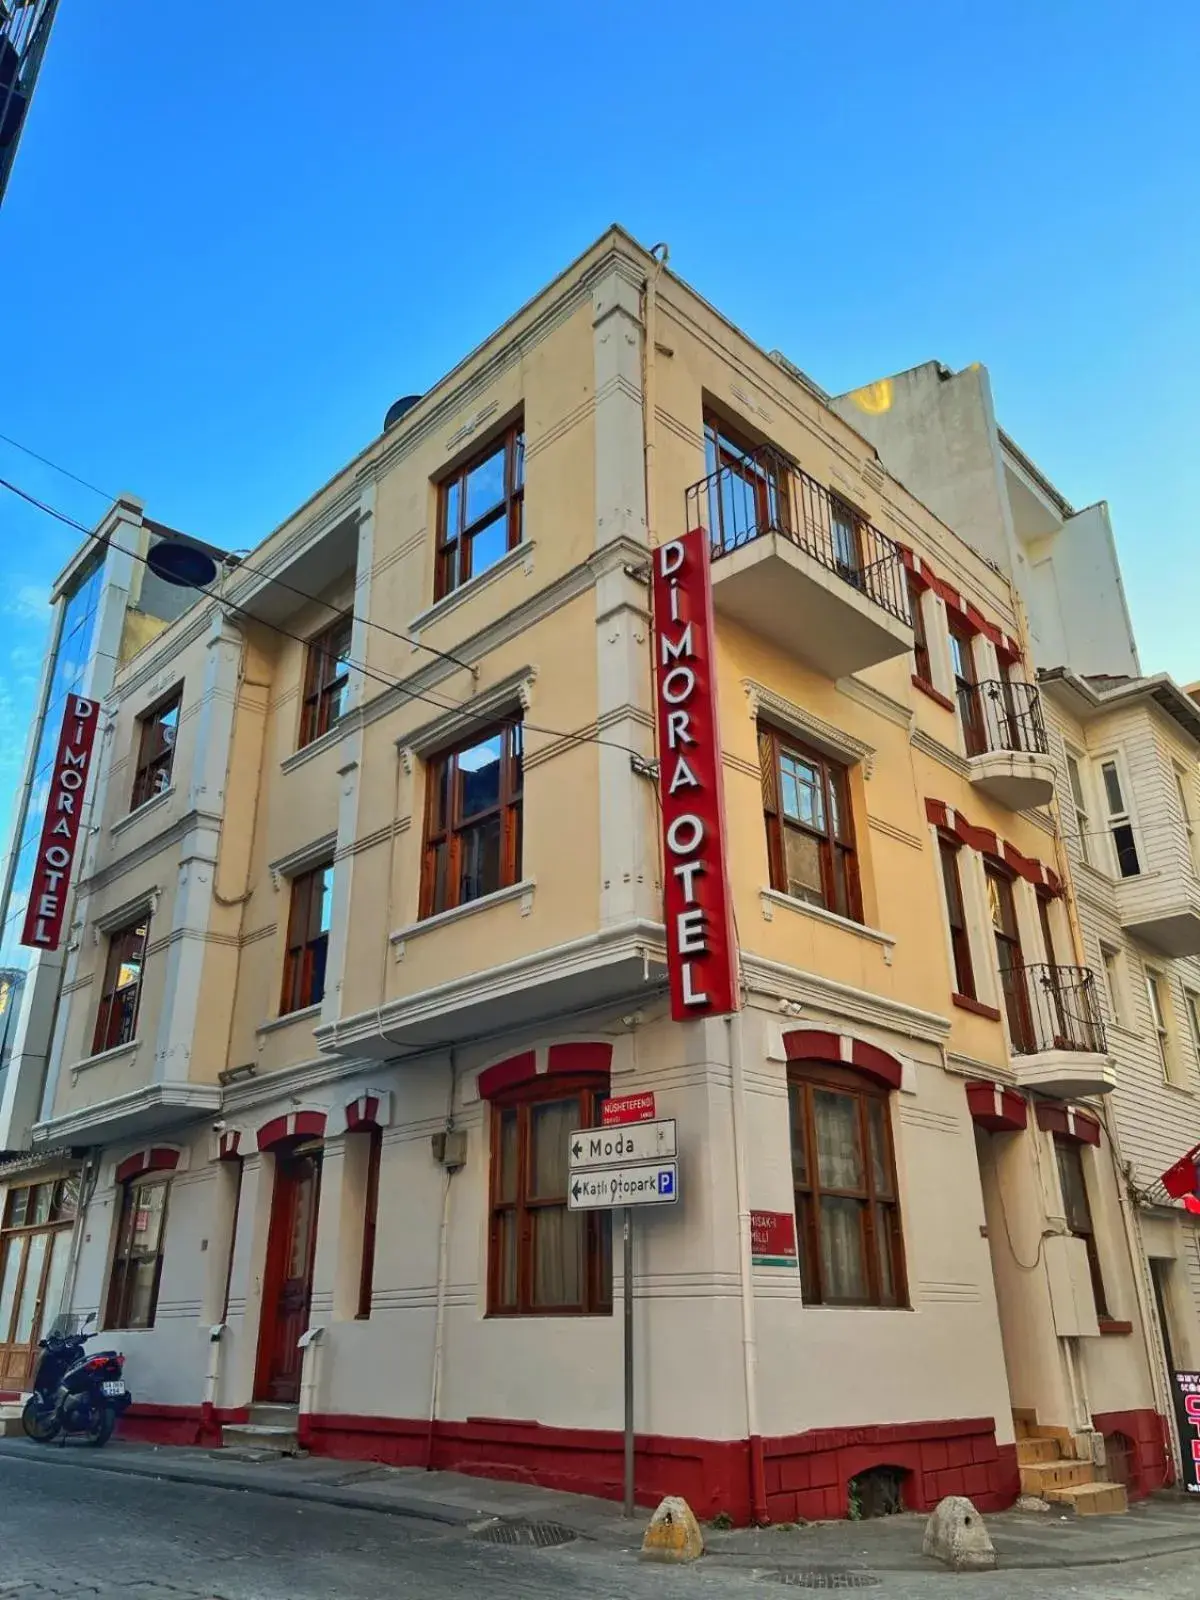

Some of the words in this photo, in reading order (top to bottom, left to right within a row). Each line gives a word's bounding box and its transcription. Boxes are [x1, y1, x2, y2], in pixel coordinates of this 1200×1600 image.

[661, 540, 698, 794] DİMORA
[52, 698, 93, 838] DİMORA
[35, 846, 70, 943] OTEL
[667, 814, 707, 1005] OTEL
[582, 1180, 607, 1196] Katlı
[610, 1176, 656, 1195] Otopark
[661, 1174, 670, 1192] P
[590, 1133, 634, 1157] Moda
